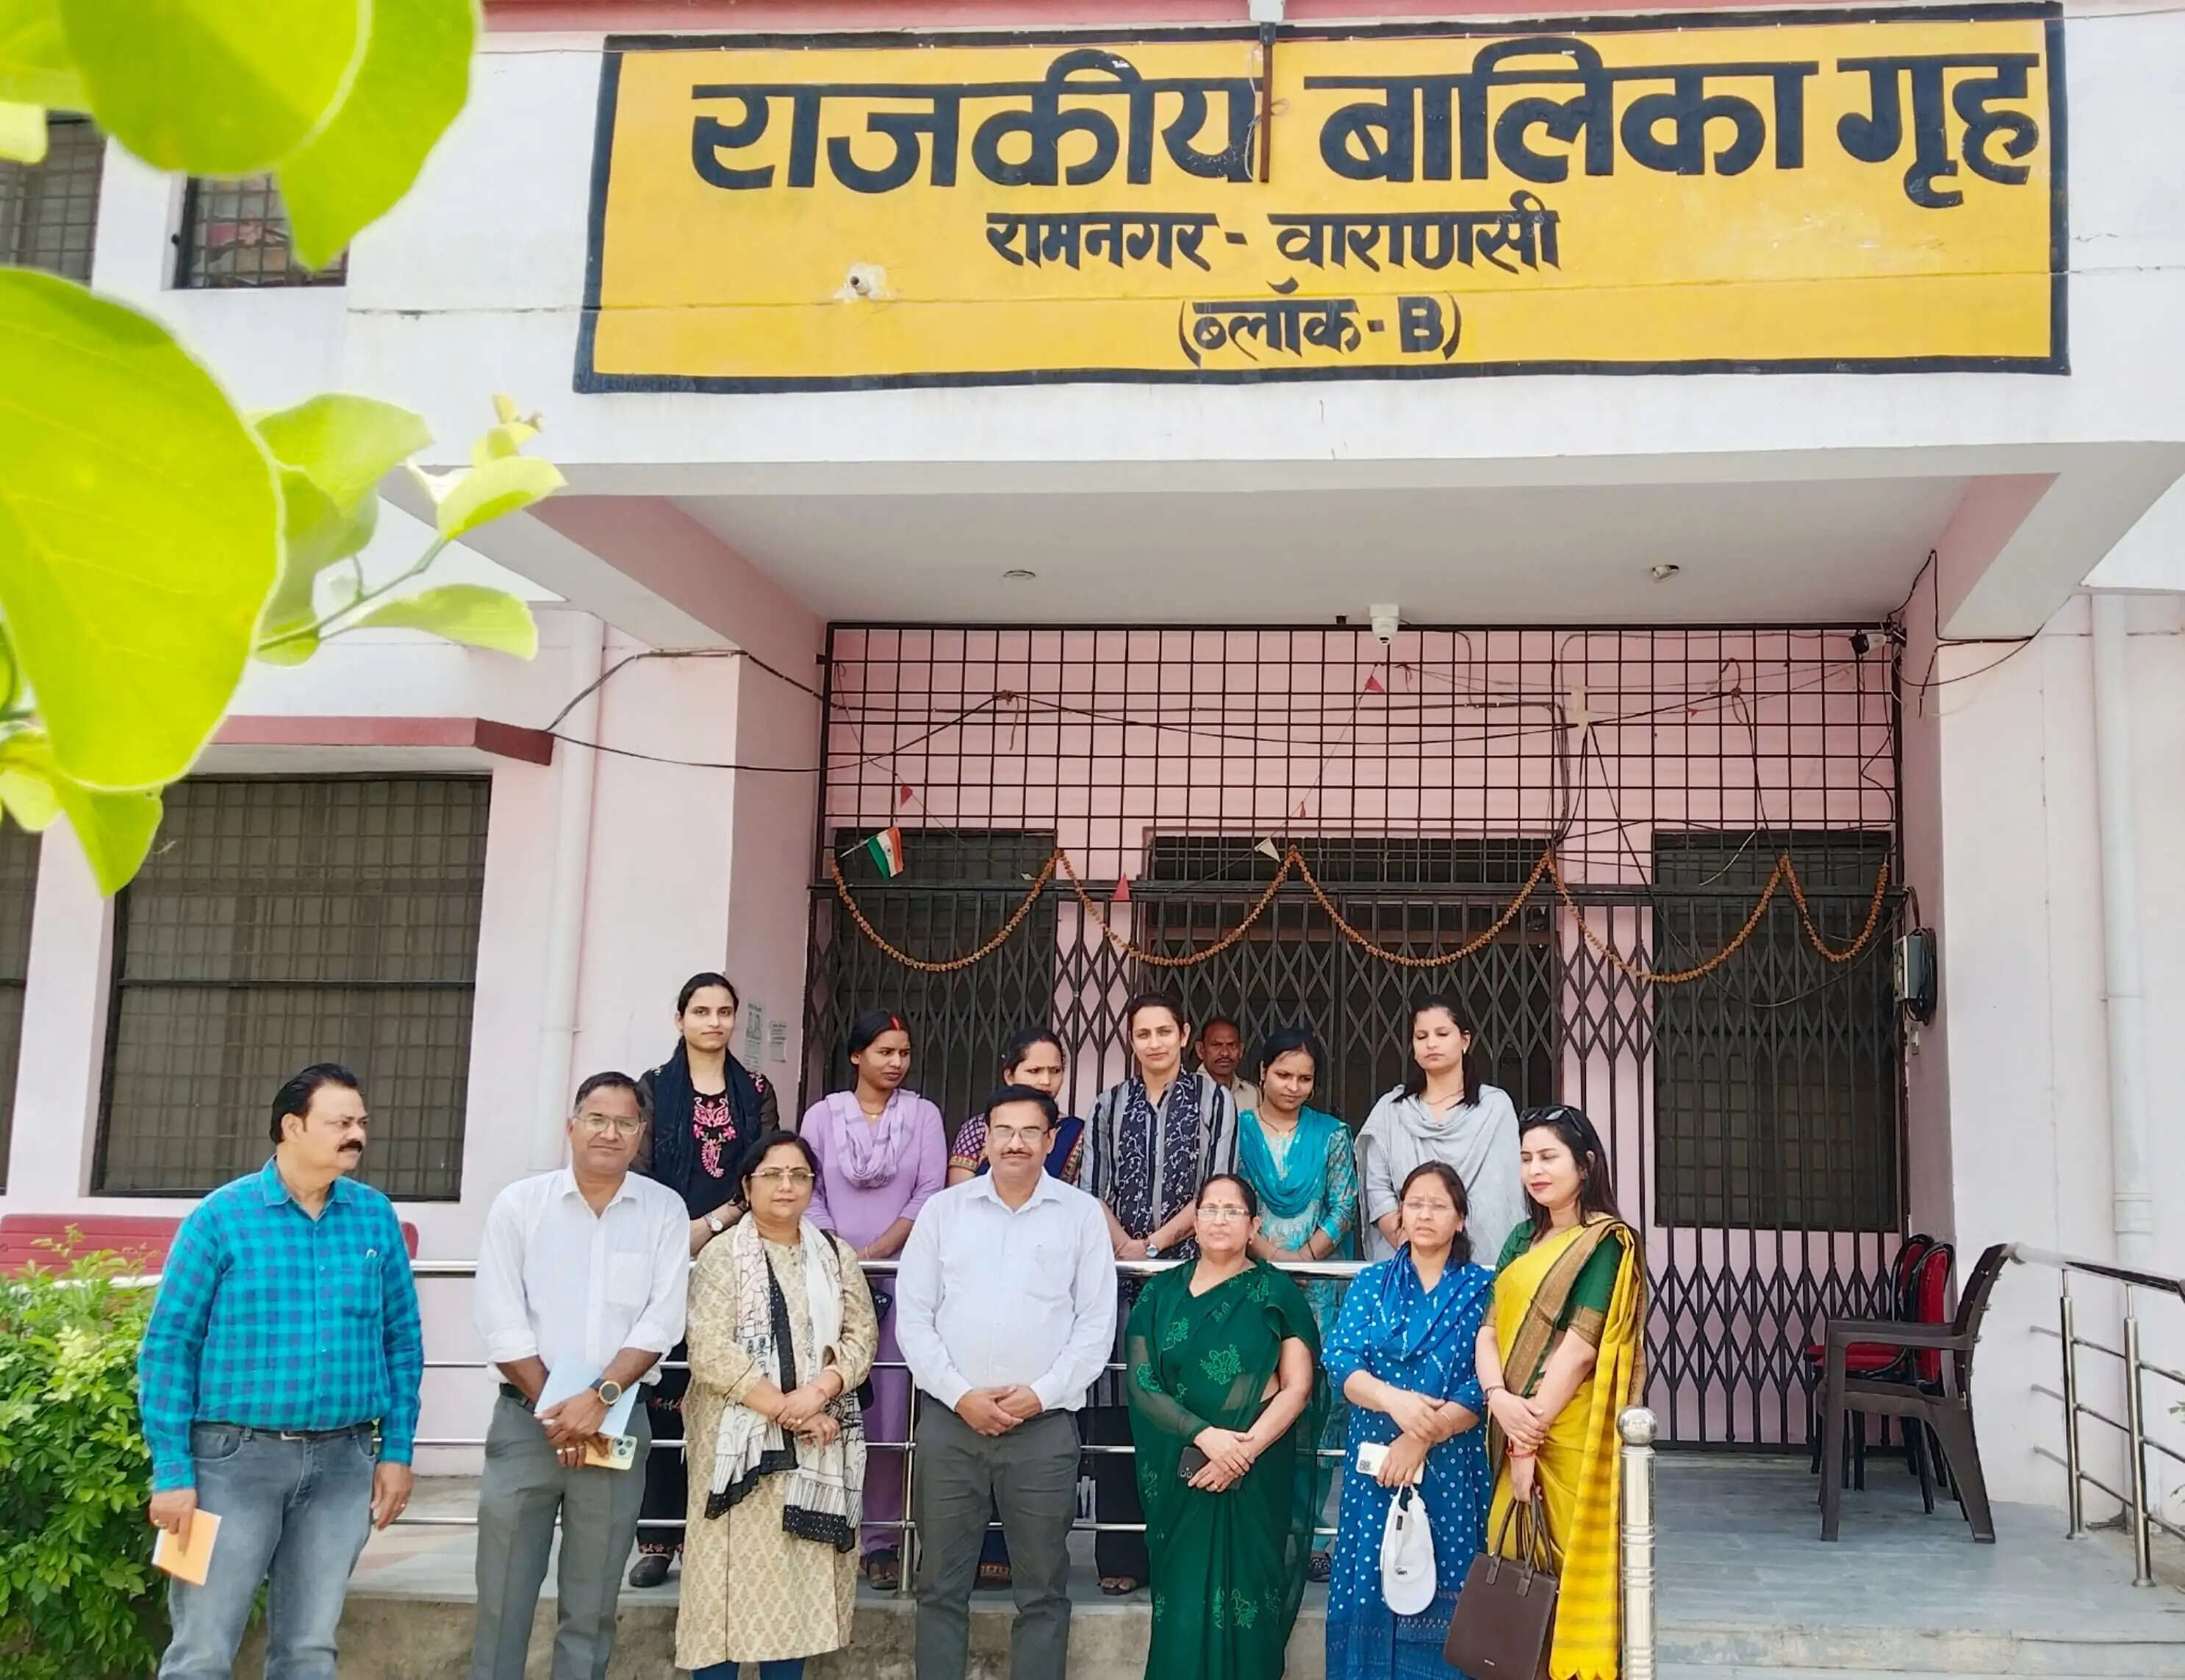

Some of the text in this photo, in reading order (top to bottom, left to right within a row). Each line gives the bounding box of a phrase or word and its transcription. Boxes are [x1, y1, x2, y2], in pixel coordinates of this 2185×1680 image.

[691, 37, 2040, 209] राजकीय बालिका गृह
[1267, 190, 1561, 274] वाराणसी
